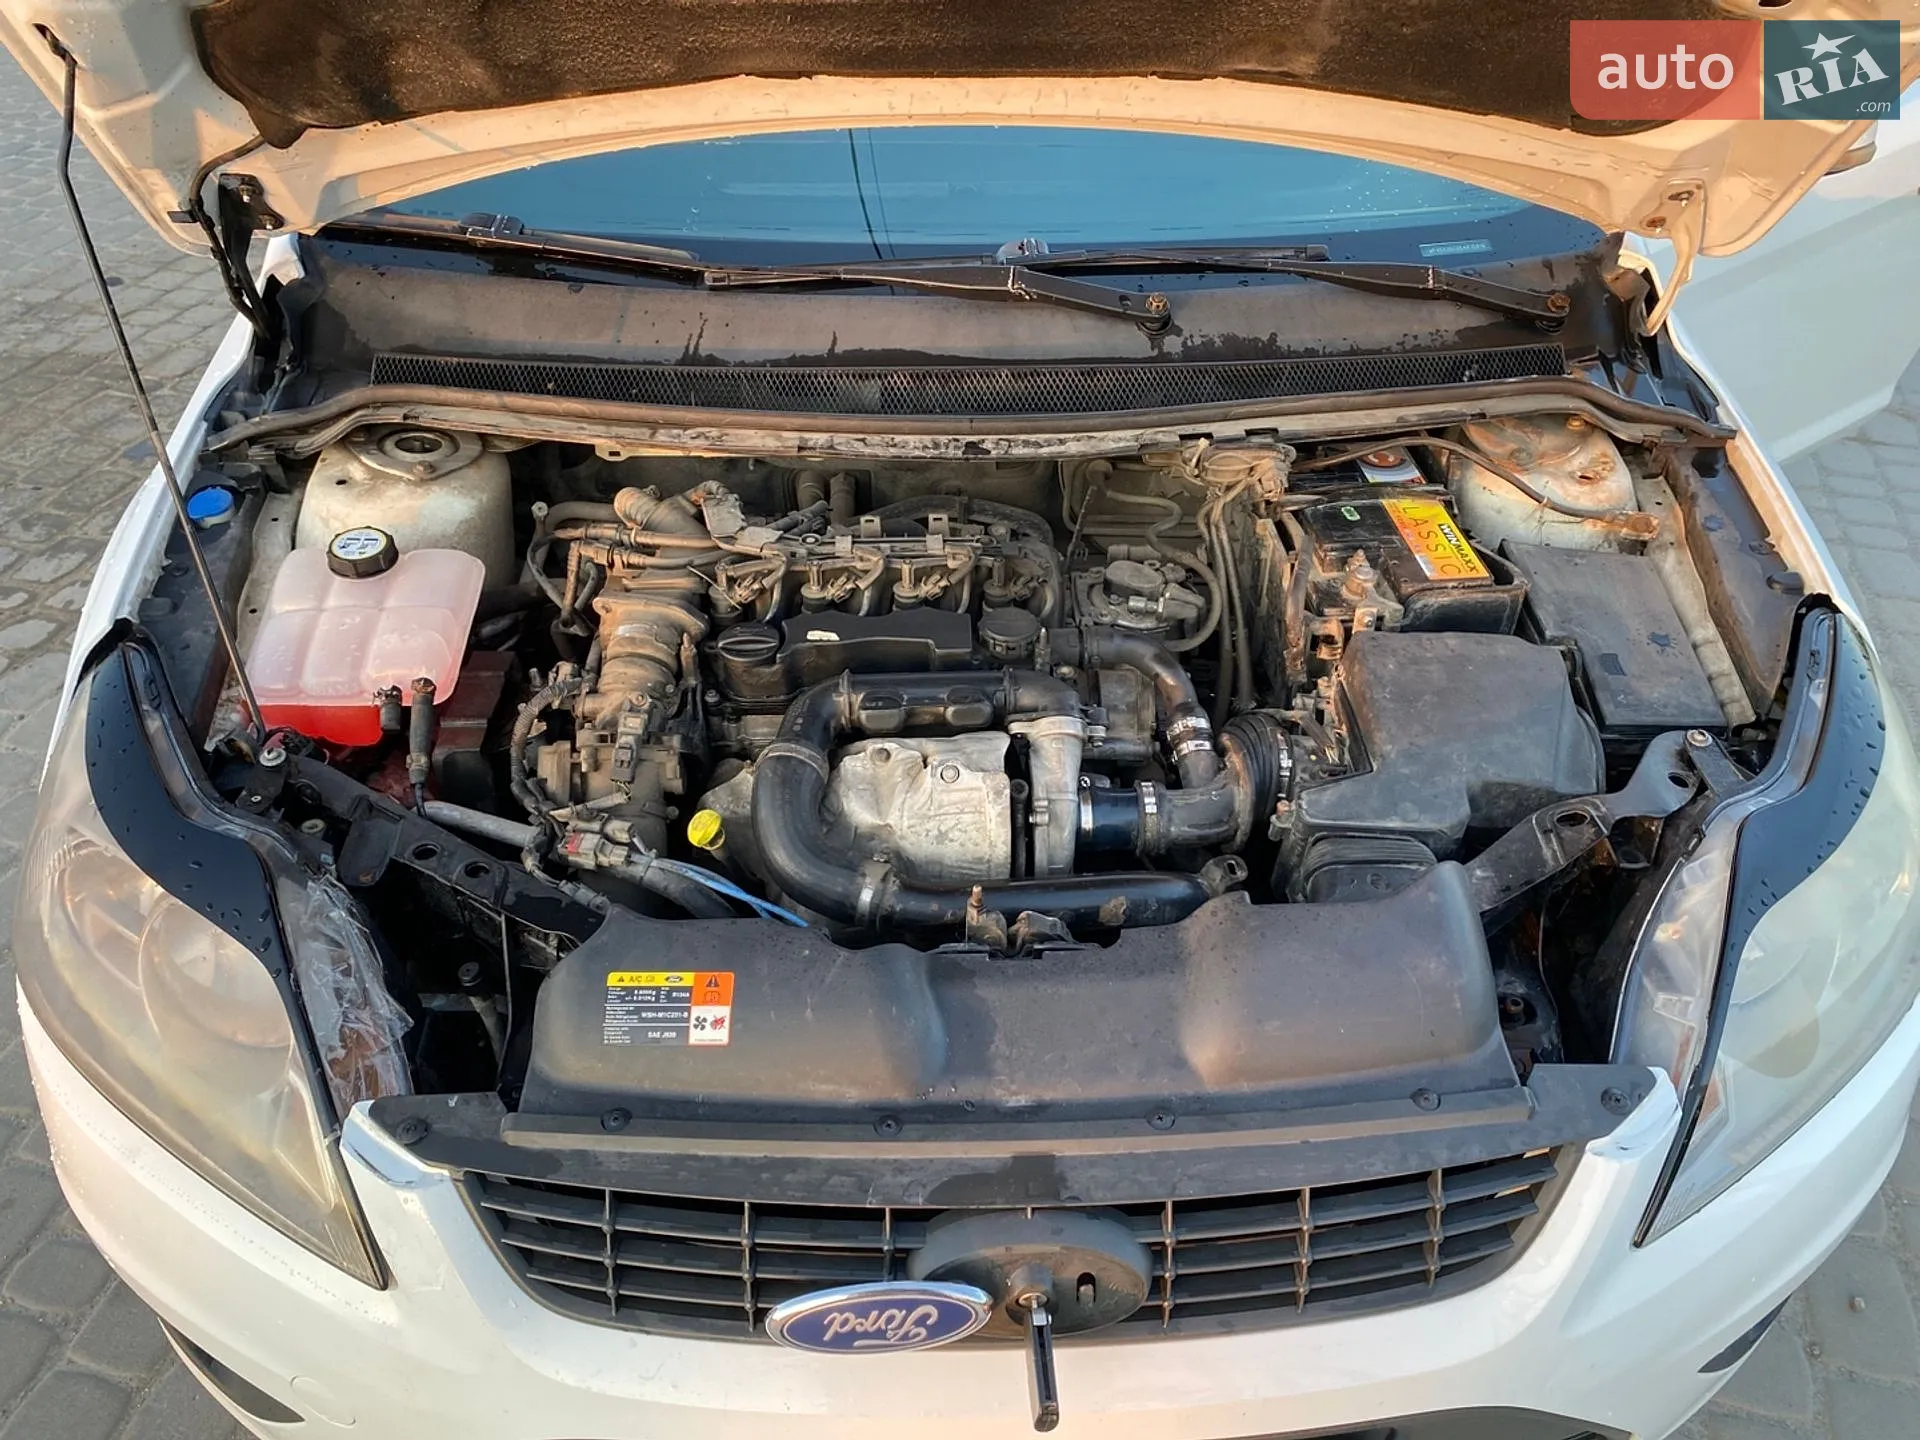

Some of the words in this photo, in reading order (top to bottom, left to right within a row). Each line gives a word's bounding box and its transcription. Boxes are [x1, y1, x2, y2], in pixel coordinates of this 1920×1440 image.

[1400, 499, 1461, 575] LASSIC
[1439, 523, 1479, 574] WINMAXX
[823, 1304, 938, 1347] Ford
